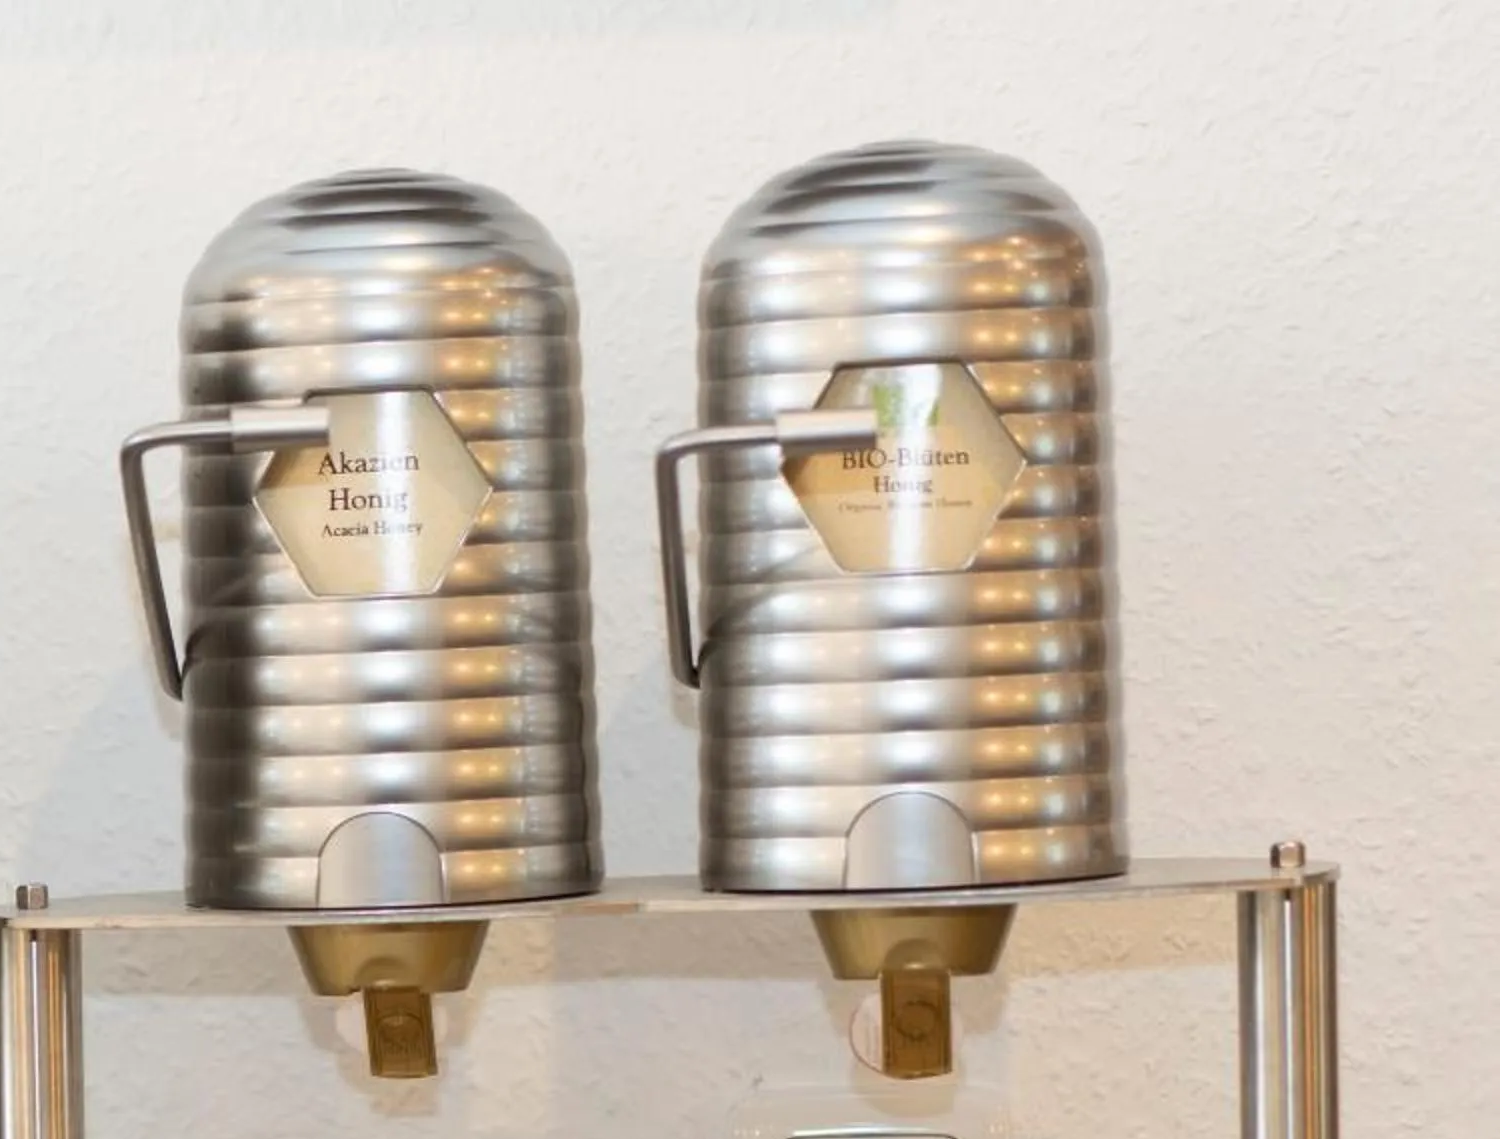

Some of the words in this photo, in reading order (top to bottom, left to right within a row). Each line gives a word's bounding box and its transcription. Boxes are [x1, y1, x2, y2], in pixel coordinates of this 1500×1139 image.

[318, 451, 420, 475] Akazien
[841, 447, 970, 470] BIO-Blüten
[328, 487, 409, 514] Honig
[321, 523, 369, 538] Acacia
